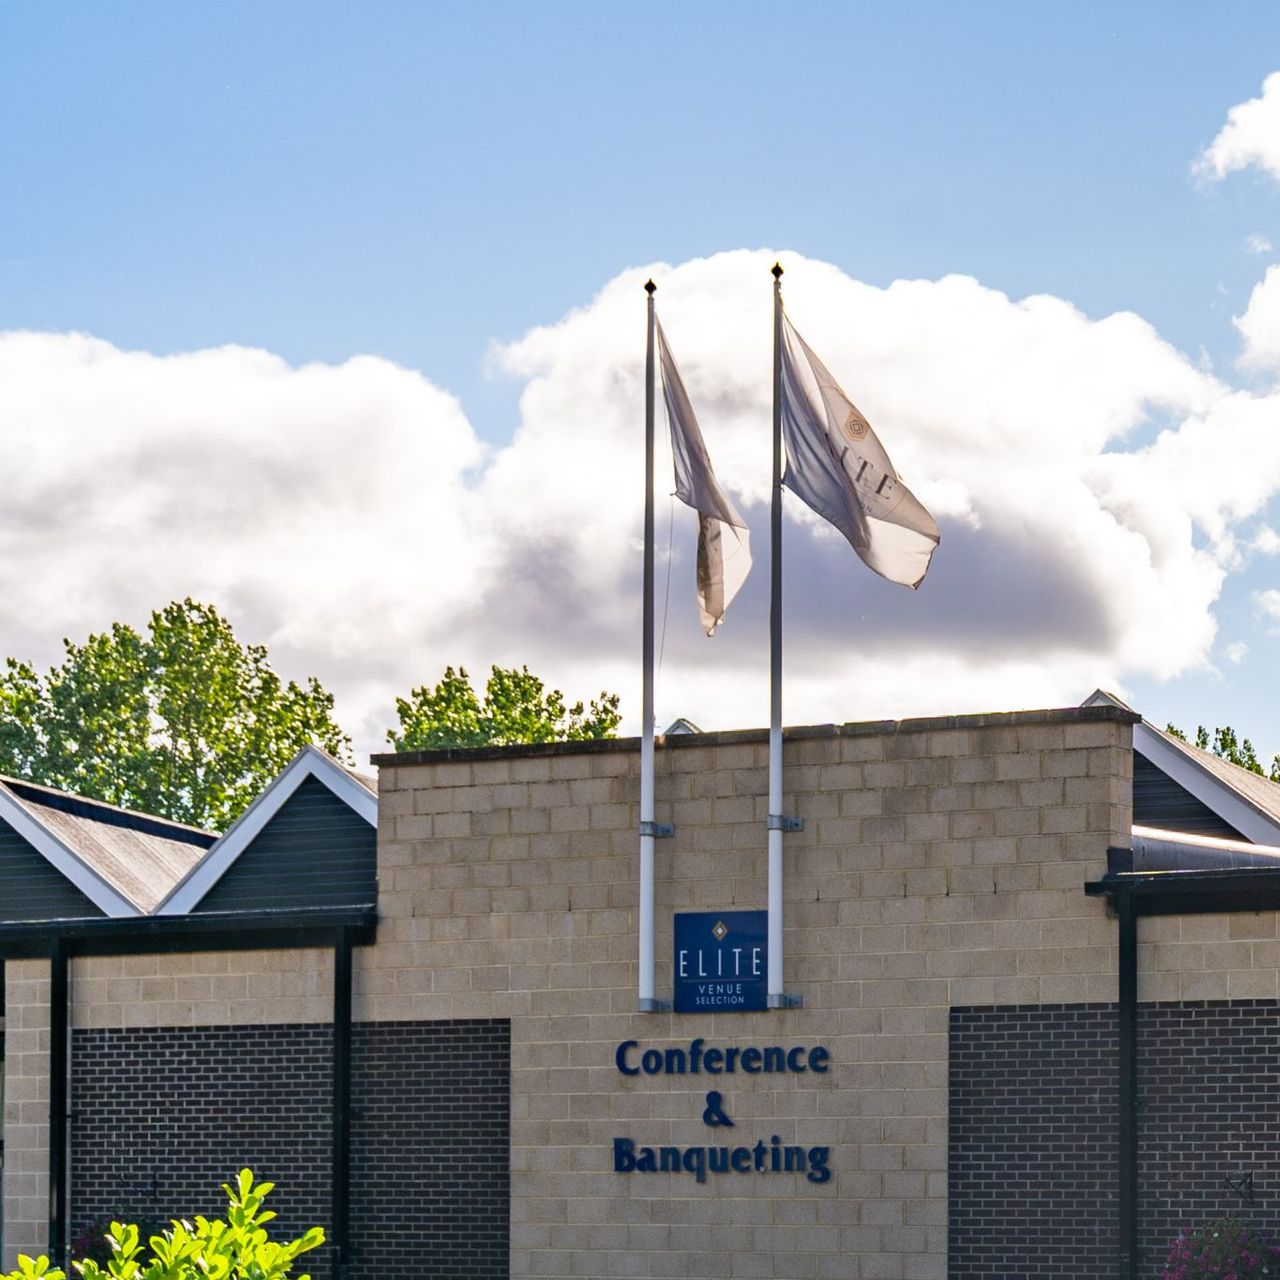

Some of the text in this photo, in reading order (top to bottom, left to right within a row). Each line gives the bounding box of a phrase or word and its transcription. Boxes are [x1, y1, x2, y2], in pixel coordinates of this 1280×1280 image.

[679, 947, 761, 977] ELITE
[695, 995, 745, 1005] SELECTION
[698, 983, 742, 995] VENUE
[615, 1038, 831, 1077] Conference
[702, 1090, 735, 1128] &
[612, 1134, 832, 1184] Banqueting
